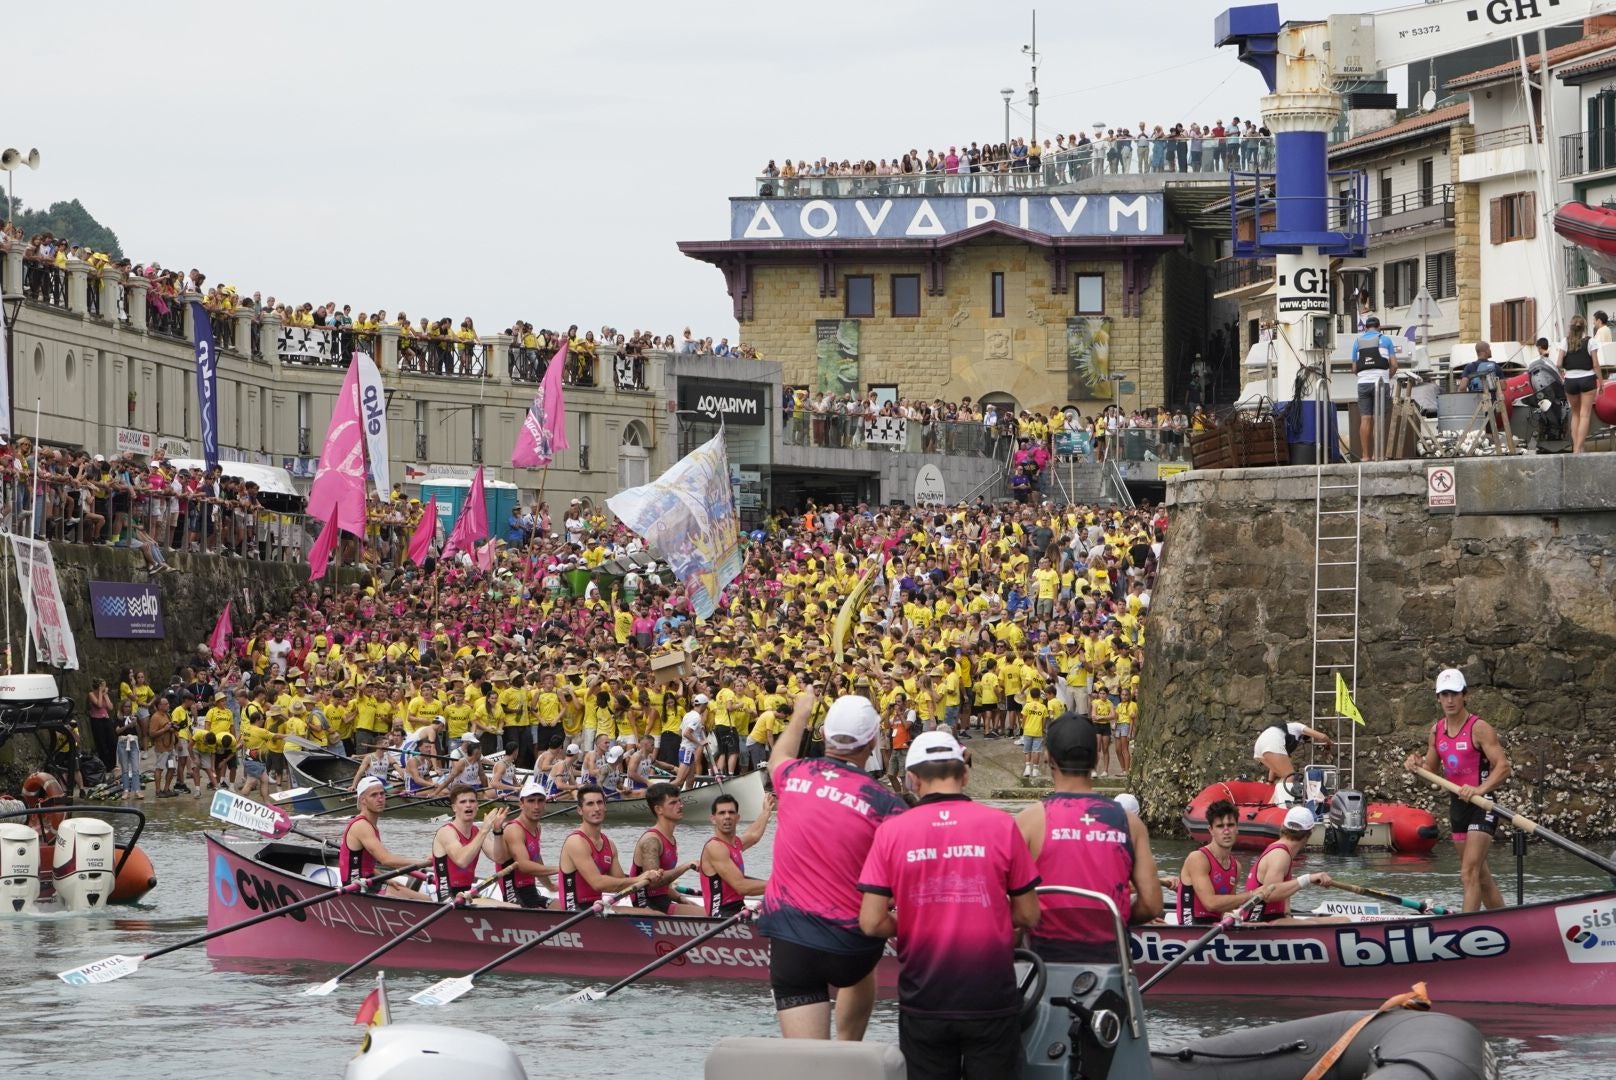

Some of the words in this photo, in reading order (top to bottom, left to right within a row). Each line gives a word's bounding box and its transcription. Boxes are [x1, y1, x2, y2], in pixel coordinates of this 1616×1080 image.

[1486, 0, 1542, 25] GH
[1411, 25, 1441, 37] 53372
[142, 588, 158, 621] ekp
[233, 798, 276, 822] MOYUA
[815, 785, 871, 816] JUAN
[1051, 828, 1081, 840] SAN
[1085, 830, 1127, 843] JUAN
[906, 848, 937, 862] SAN
[942, 845, 985, 858] JUAN
[236, 868, 307, 922] CMO
[297, 889, 432, 943] VALVES
[1327, 903, 1363, 915] MOYUA
[655, 921, 753, 940] JUNKERS
[1338, 924, 1508, 967] bike
[80, 957, 123, 977] MOYUA
[685, 947, 770, 967] BOSCH
